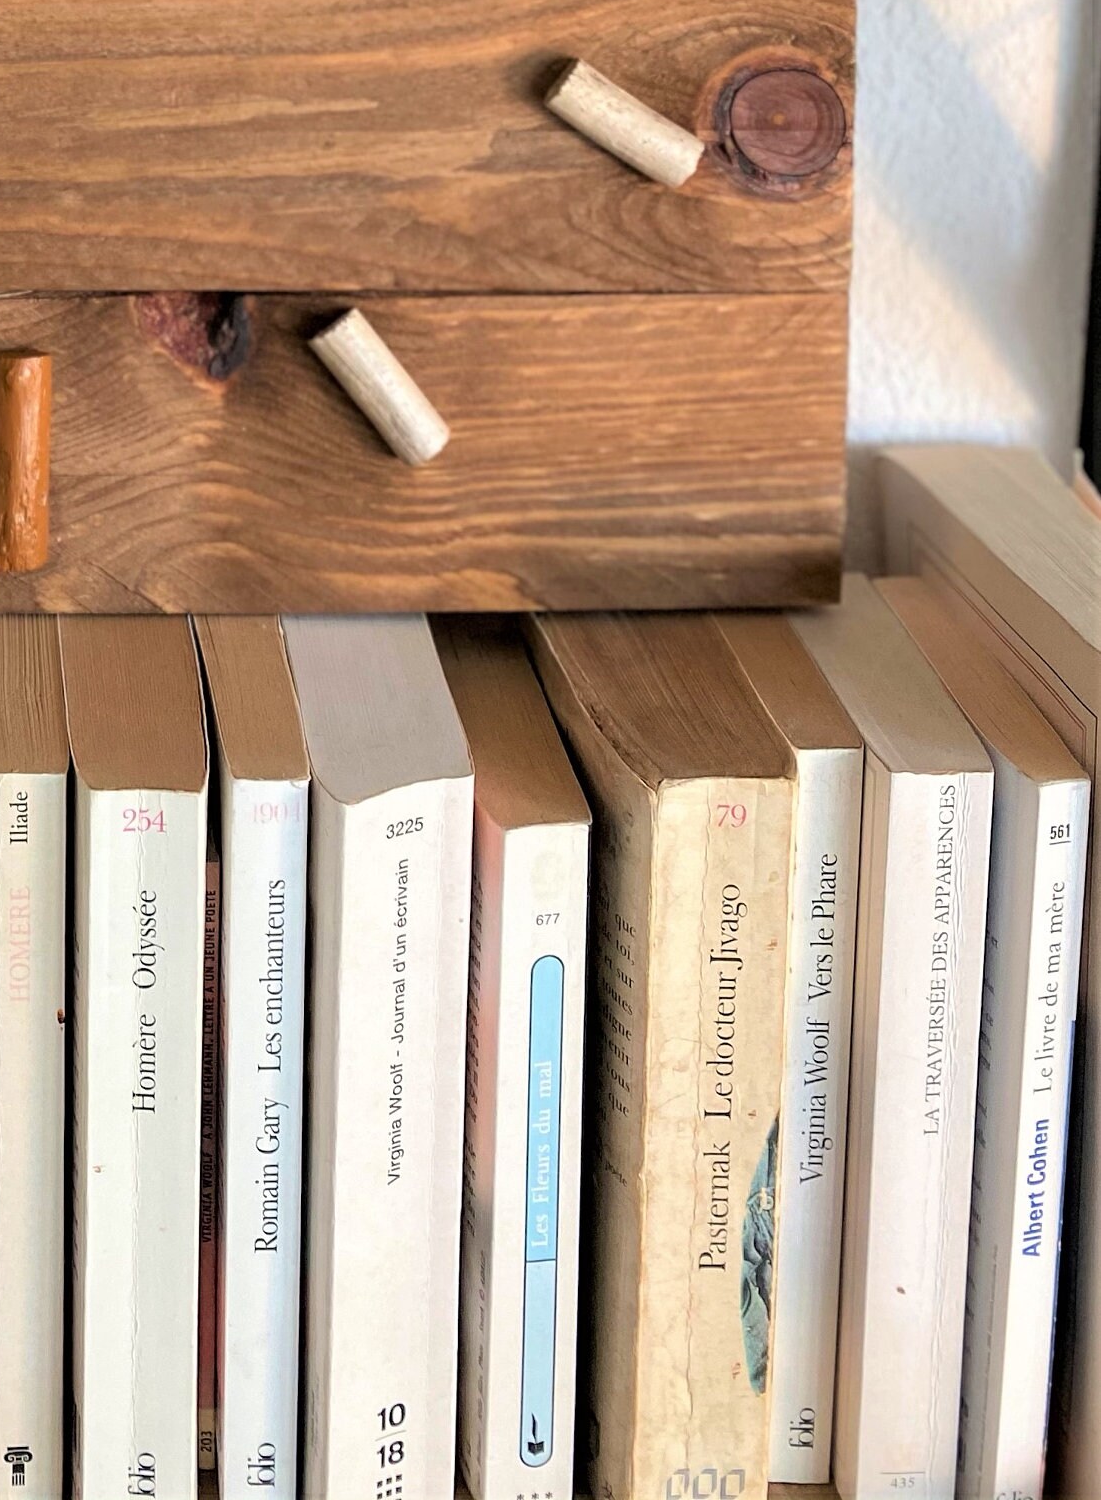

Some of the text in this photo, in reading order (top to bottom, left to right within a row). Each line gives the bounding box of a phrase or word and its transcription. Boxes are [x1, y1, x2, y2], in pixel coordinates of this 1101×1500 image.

[9, 791, 28, 845] Iliade
[122, 808, 167, 832] 254
[386, 816, 424, 839] 3225
[717, 804, 746, 828] 79
[1050, 824, 1070, 839] 561
[393, 858, 409, 928] écrivain
[536, 913, 560, 926] 677
[615, 913, 636, 938] que
[205, 927, 215, 961] JEUNE
[923, 785, 956, 1135] LA TRAVERSÉE DES APPARENCES
[205, 966, 214, 981] UN
[617, 968, 635, 989] sur
[132, 890, 165, 1113] Homère Odyssée
[204, 997, 214, 1033] LETTRE
[390, 978, 405, 1044] Journal
[799, 853, 838, 1185] Virginia Woolf Vers le Phare
[254, 879, 289, 1254] Romain Gary Les enchanteurs
[698, 884, 748, 1271] Pasternak Le docteur Jivago
[1022, 881, 1065, 1257] Albert Cohen Le livre de ma mère
[388, 1063, 403, 1115] Woolf
[203, 1100, 213, 1125] JOHN
[203, 1152, 213, 1188] WOOLF
[387, 1118, 404, 1186] Virginia
[530, 1060, 552, 1248] Les Fleurs du mal
[202, 1192, 212, 1243] VIRGINIA
[377, 1403, 406, 1431] 10
[789, 1408, 815, 1449] folio
[200, 1431, 212, 1452] 203
[376, 1441, 404, 1469] 18
[128, 1452, 156, 1498] folio
[247, 1443, 276, 1487] folio
[890, 1477, 915, 1488] 435
